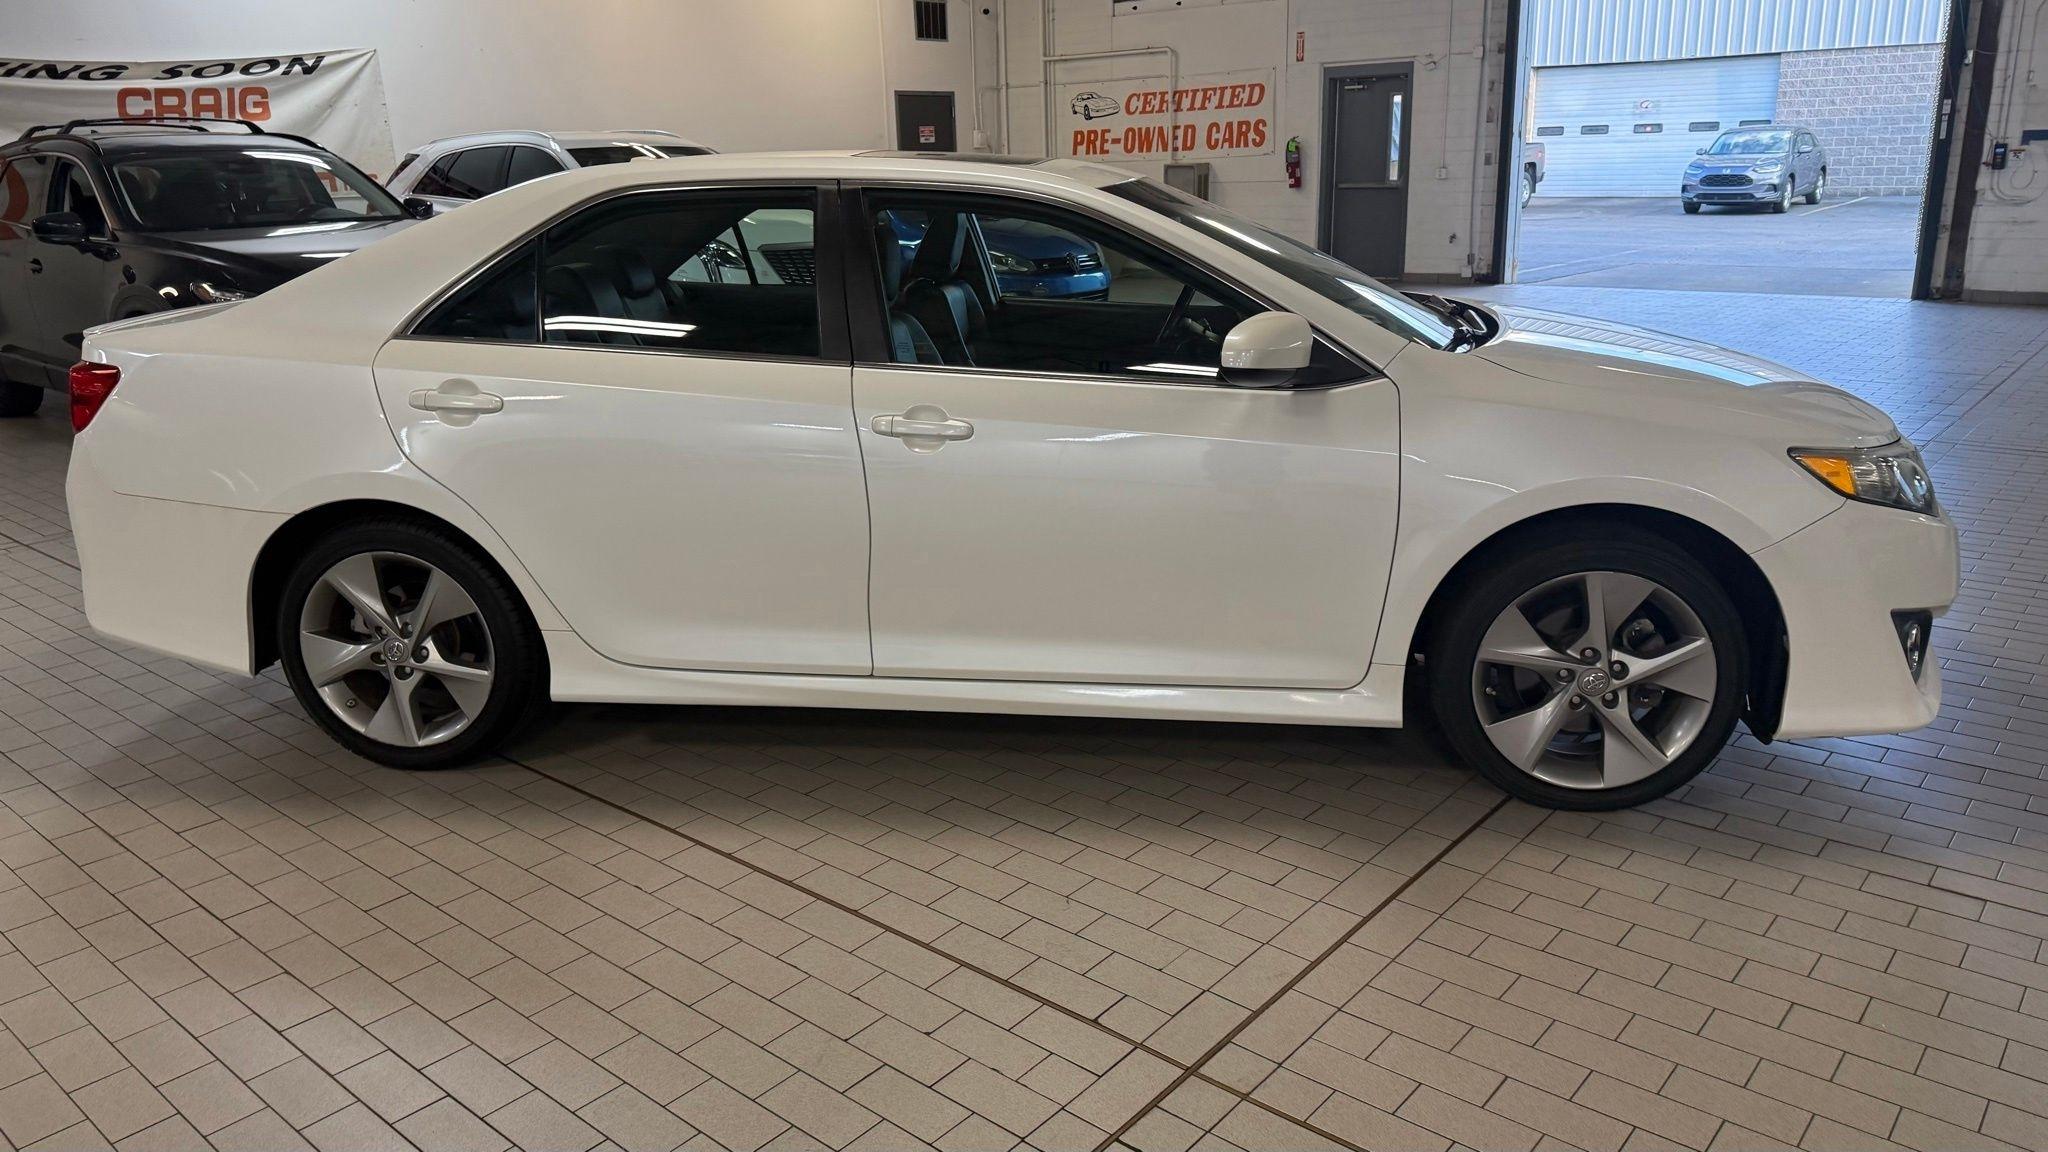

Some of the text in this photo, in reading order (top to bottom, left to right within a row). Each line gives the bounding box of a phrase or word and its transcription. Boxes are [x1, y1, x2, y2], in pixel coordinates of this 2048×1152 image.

[0, 56, 325, 81] ING SOON
[117, 87, 271, 123] CRAIG
[1072, 119, 1267, 156] PRE-OWNED CARS
